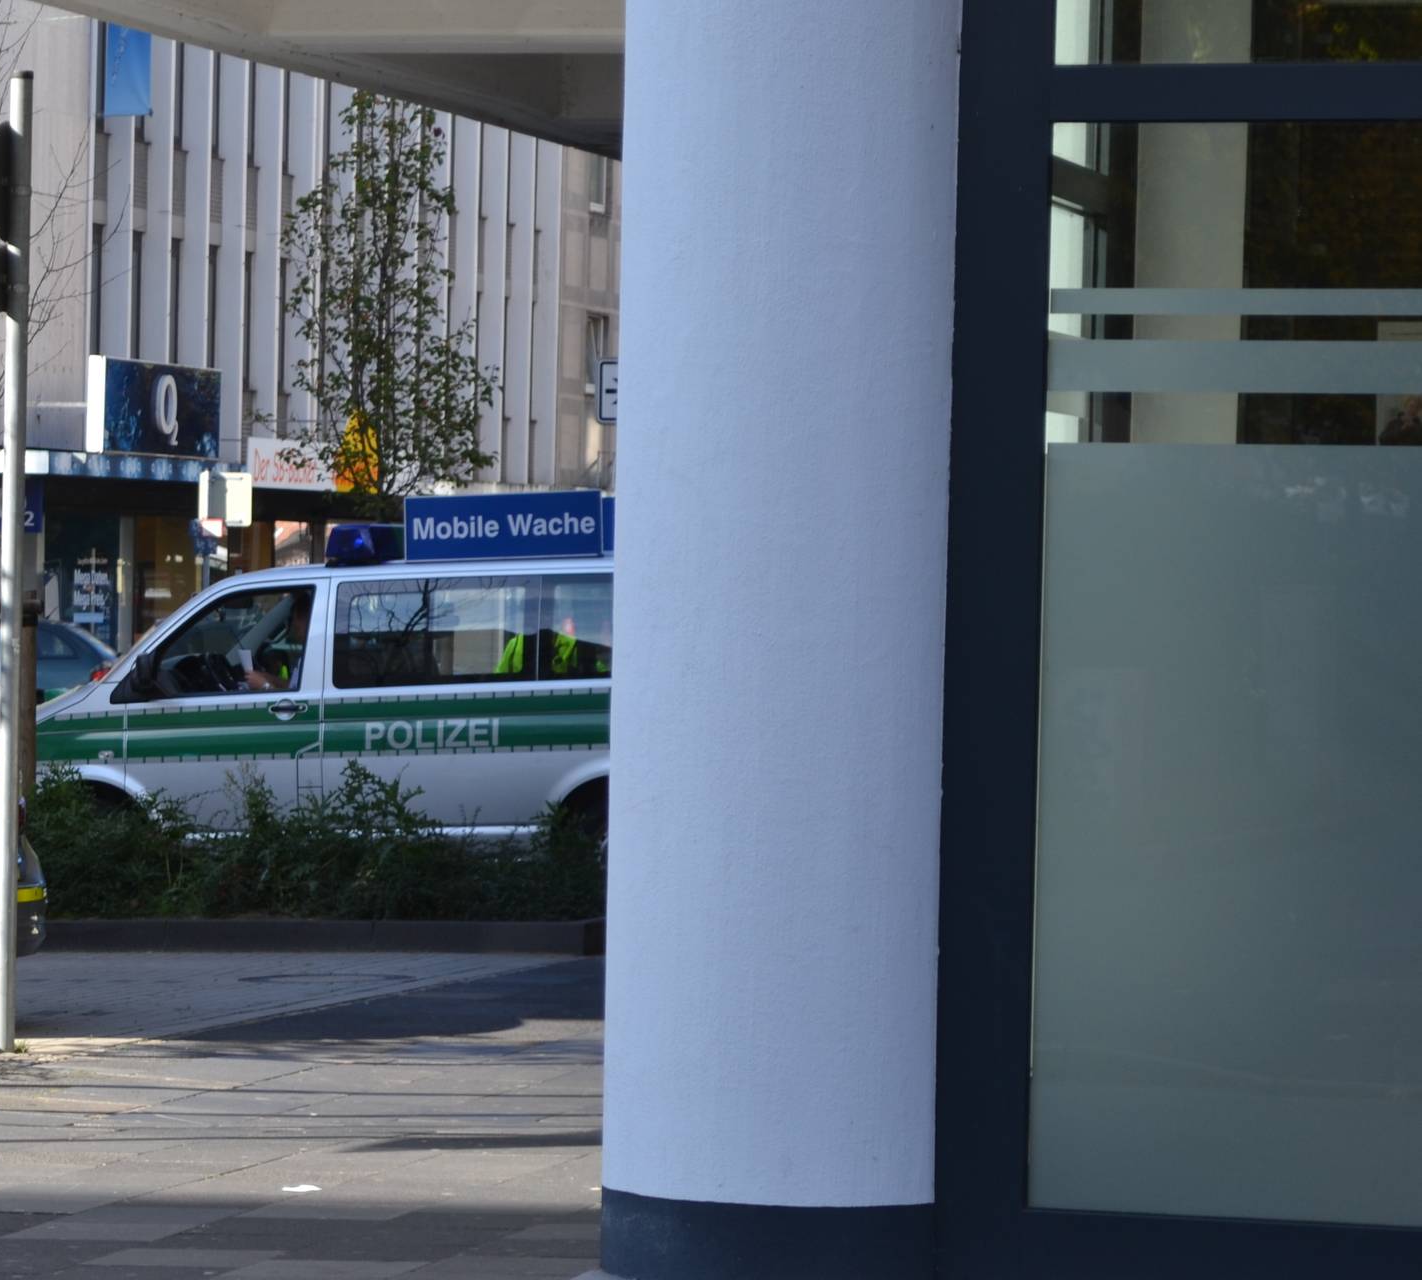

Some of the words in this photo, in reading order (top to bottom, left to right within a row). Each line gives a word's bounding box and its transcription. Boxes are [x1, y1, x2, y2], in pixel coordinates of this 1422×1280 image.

[412, 516, 500, 540] Mobile
[507, 512, 596, 537] Wache
[365, 717, 500, 750] POLIZEI
